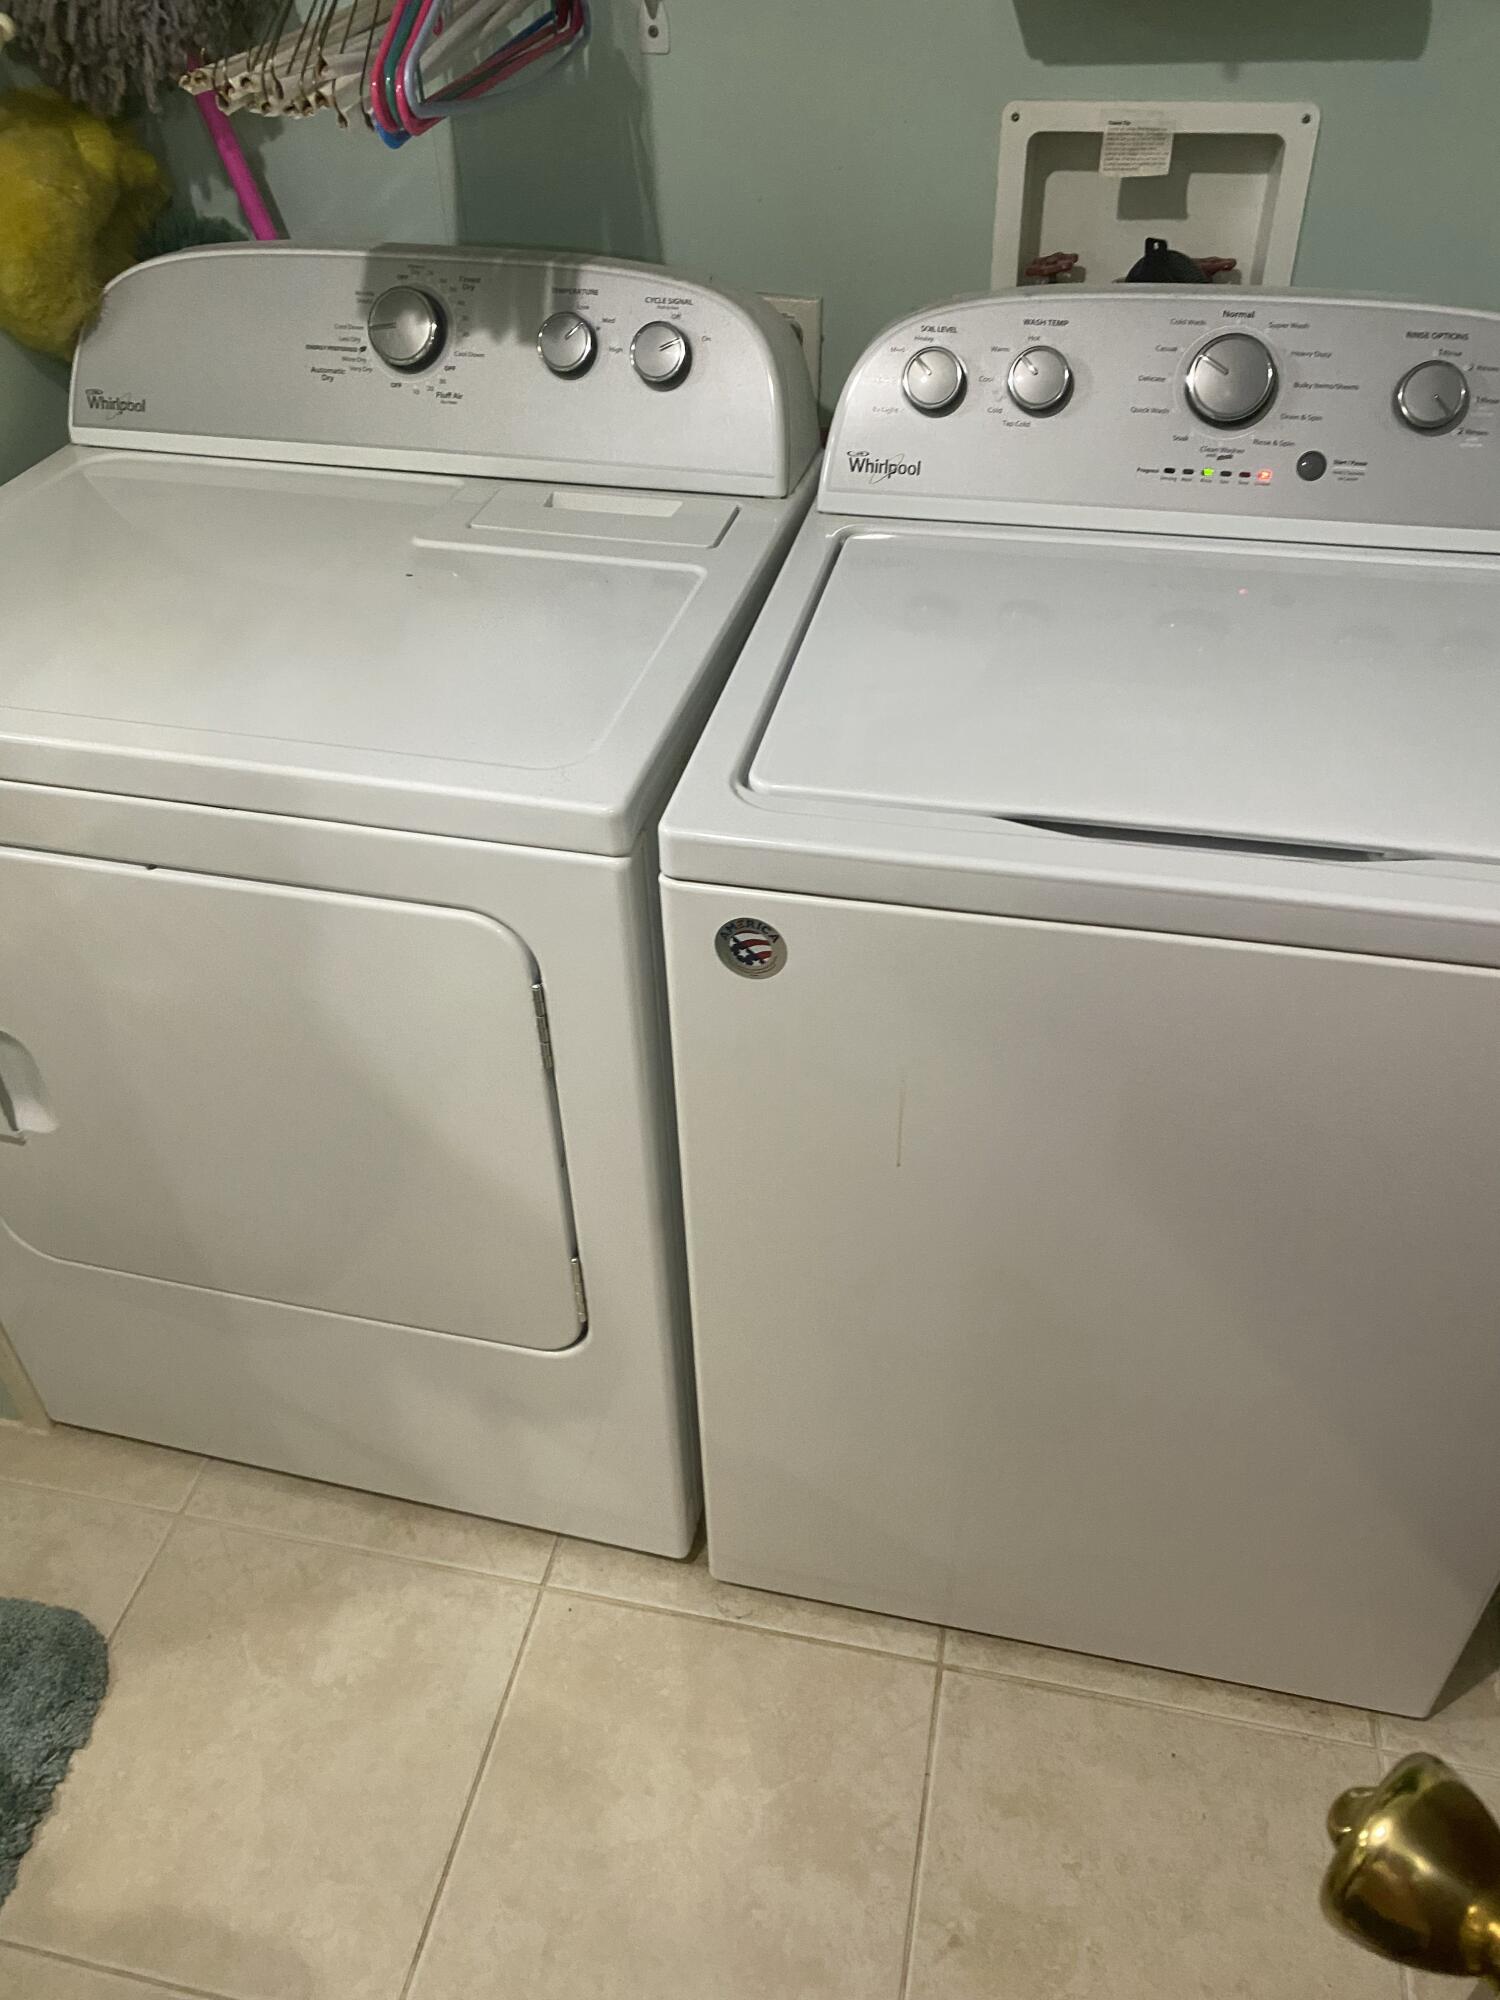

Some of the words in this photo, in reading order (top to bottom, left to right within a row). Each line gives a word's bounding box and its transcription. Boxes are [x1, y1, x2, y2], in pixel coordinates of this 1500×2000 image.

[644, 296, 667, 305] CYCLE
[667, 298, 694, 306] SIGNAL
[1222, 310, 1256, 319] Normal
[1022, 318, 1047, 327] WASH
[1047, 319, 1069, 327] TEMP
[937, 325, 958, 334] LEVEL
[1431, 332, 1469, 341] OPTIONS
[86, 390, 147, 416] Whirlpool
[848, 456, 922, 479] Whirlpool
[719, 919, 780, 944] AMERICA
